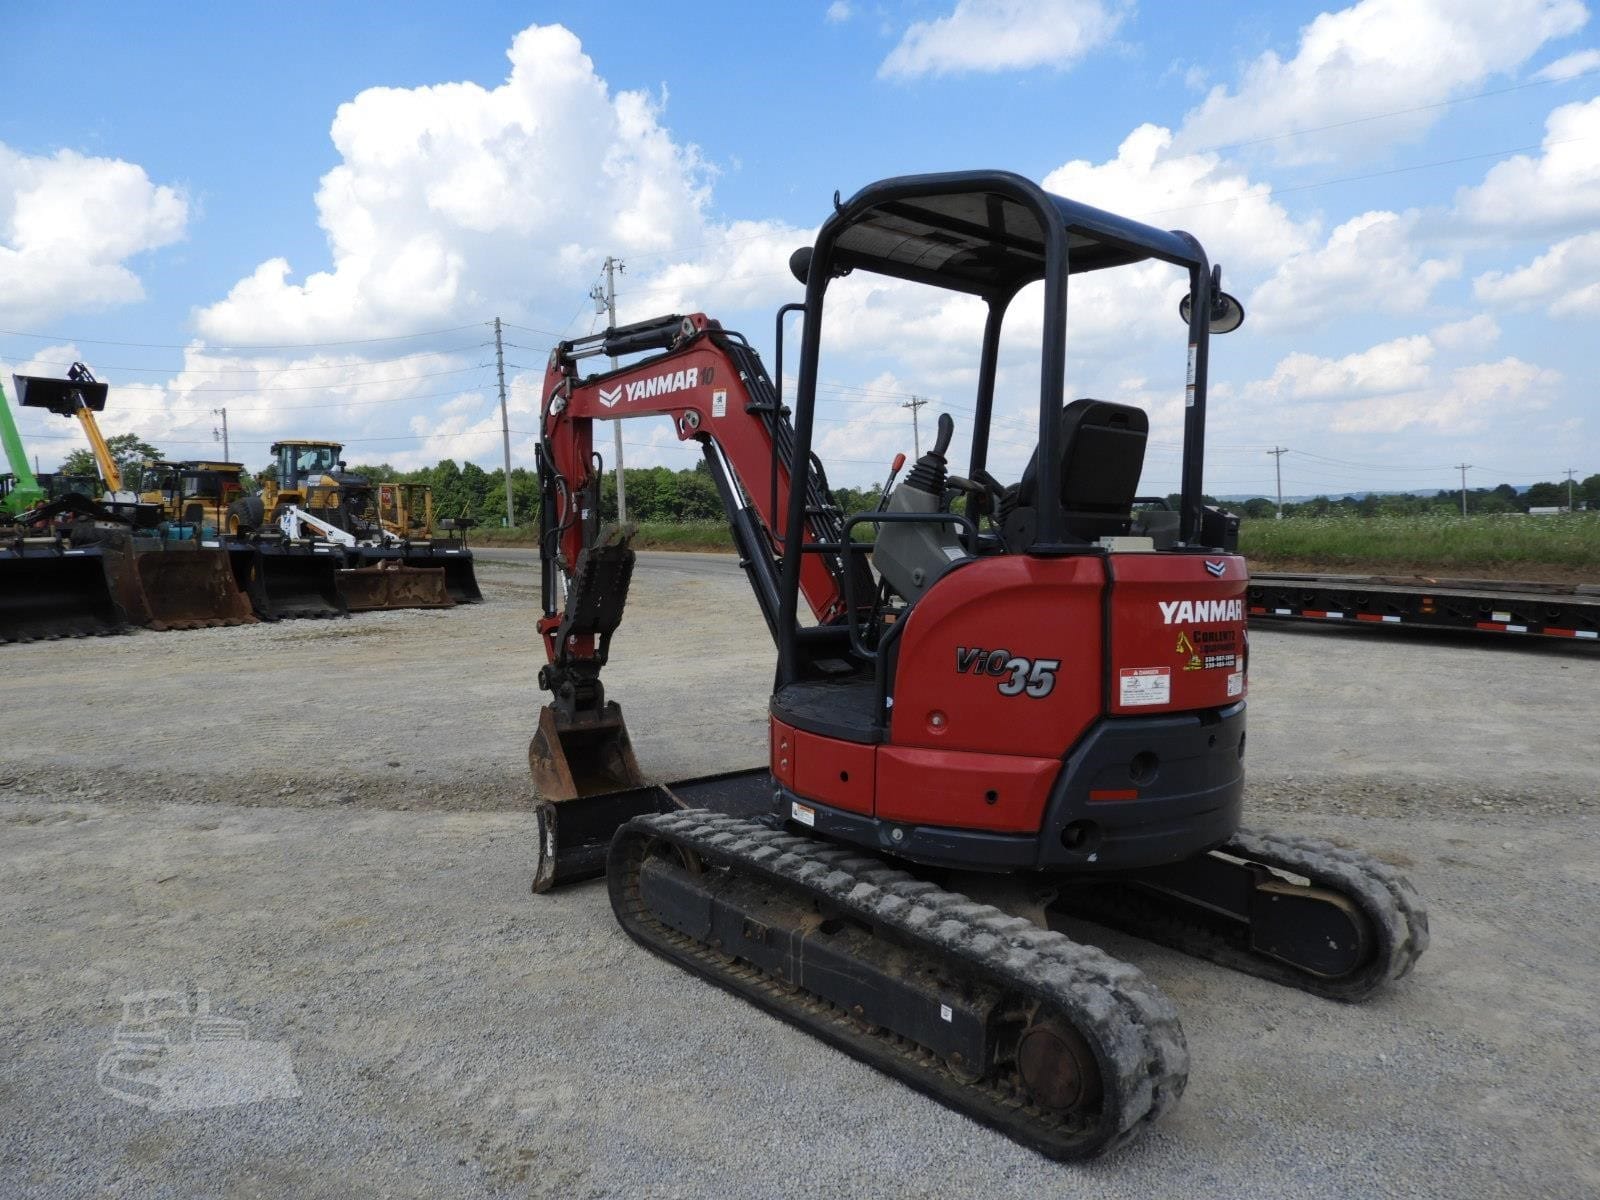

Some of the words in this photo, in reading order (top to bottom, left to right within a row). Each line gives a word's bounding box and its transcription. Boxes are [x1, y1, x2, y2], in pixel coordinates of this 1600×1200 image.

[625, 367, 698, 402] YANMAR
[1158, 599, 1243, 625] YANMAR
[997, 656, 1061, 699] 35
